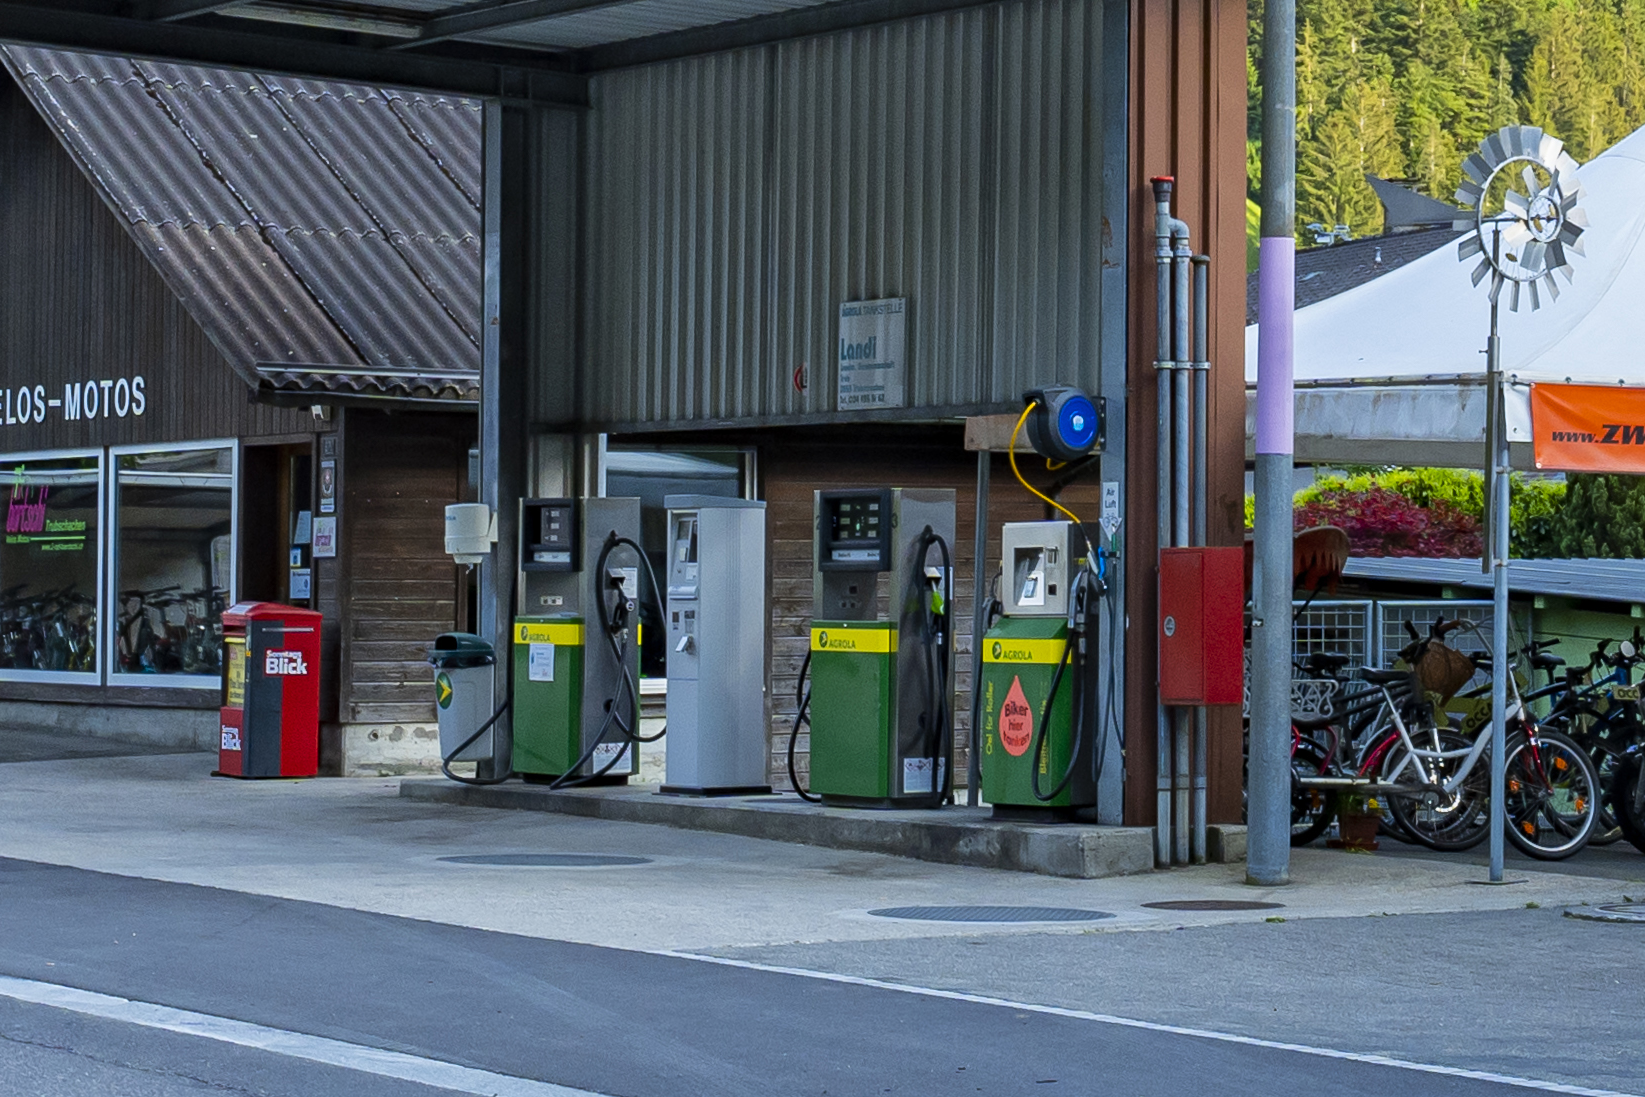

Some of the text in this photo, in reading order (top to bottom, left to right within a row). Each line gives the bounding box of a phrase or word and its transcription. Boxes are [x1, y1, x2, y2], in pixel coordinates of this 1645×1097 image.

[829, 638, 856, 650] AGROLA
[1002, 650, 1033, 661] AGROLA
[265, 658, 308, 675] Blick
[1004, 700, 1029, 718] Biker
